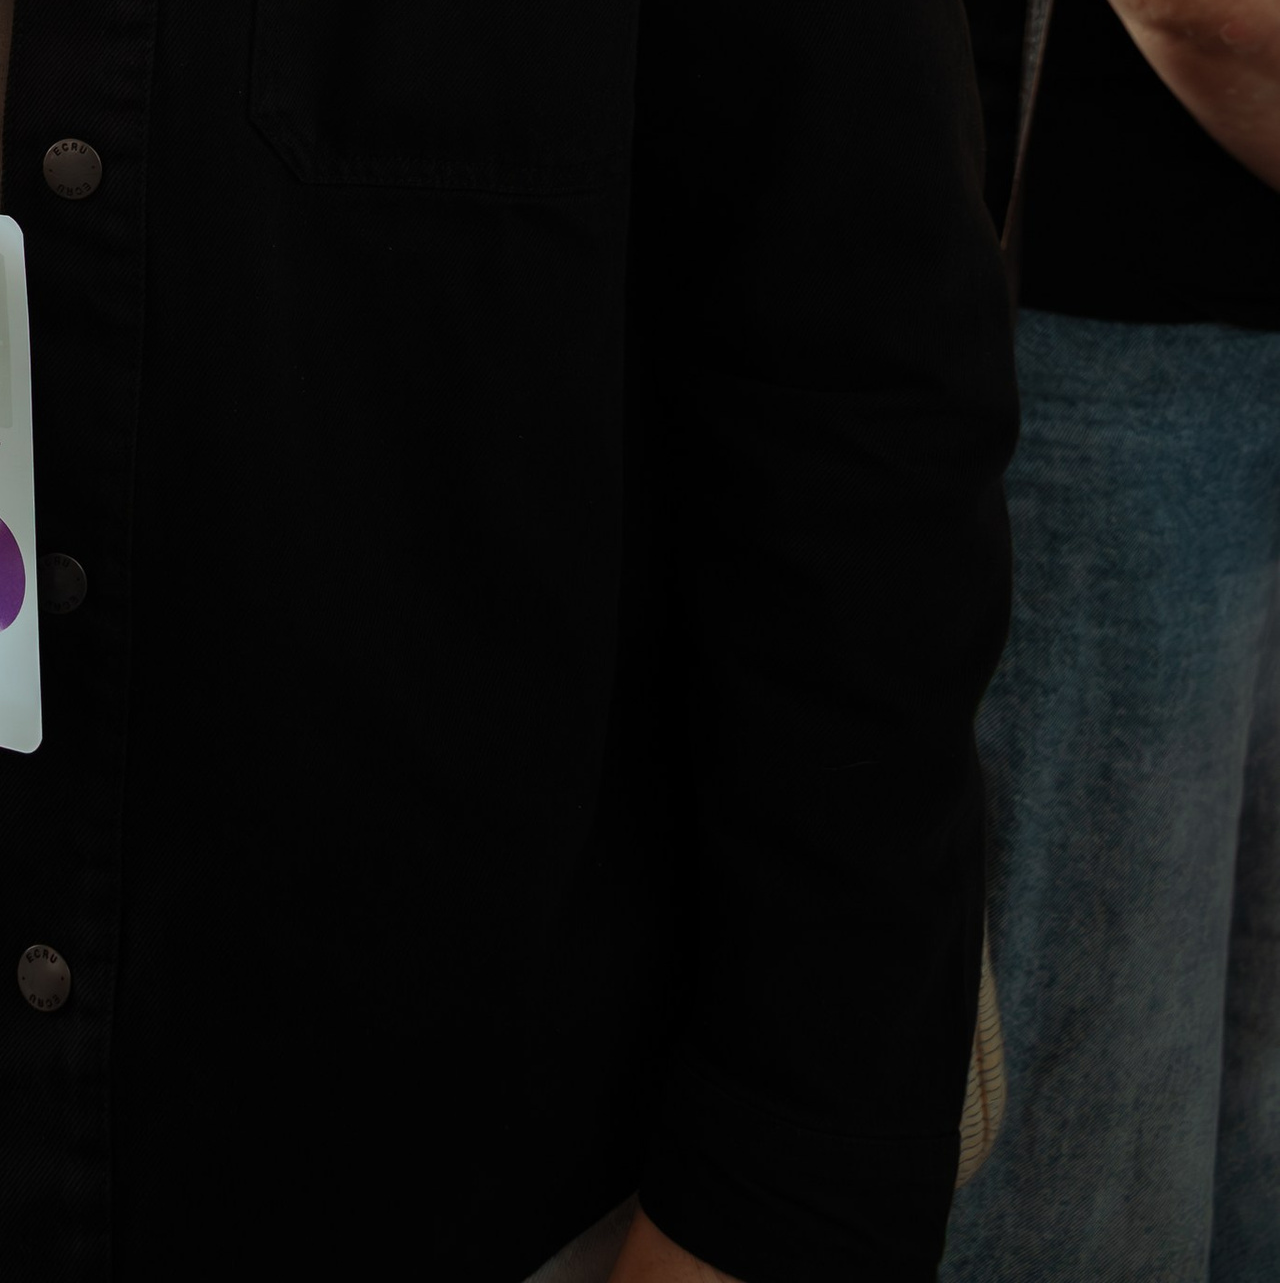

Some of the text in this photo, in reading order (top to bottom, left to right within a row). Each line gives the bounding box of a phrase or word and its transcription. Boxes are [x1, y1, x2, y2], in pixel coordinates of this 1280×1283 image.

[52, 142, 88, 156] ECRU
[56, 182, 92, 196] ECRU
[25, 948, 58, 964] ECRU
[29, 993, 61, 1008] ECRU
